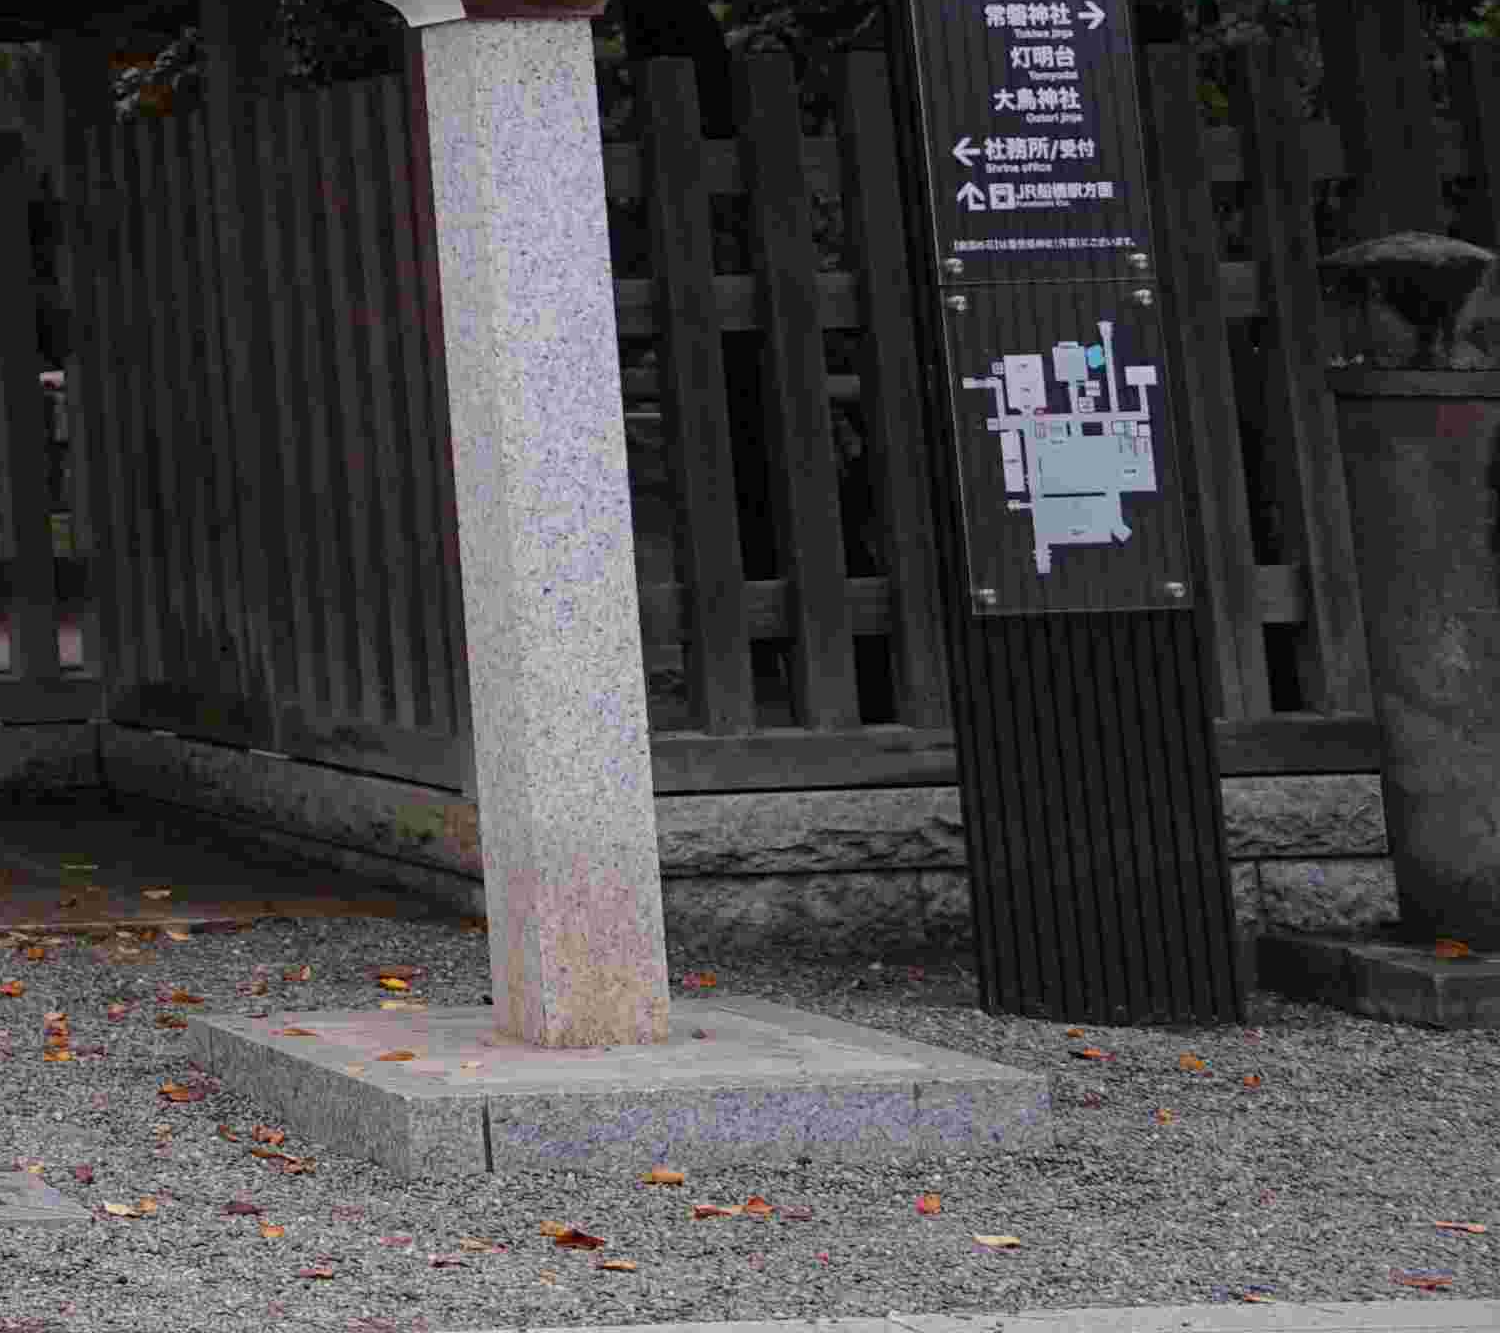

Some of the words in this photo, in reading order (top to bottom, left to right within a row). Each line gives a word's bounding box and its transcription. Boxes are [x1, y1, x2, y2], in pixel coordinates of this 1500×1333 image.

[1010, 45, 1075, 68] 灯明台
[993, 87, 1081, 111] 大鳥神社
[984, 137, 1095, 161] 社務所/受付
